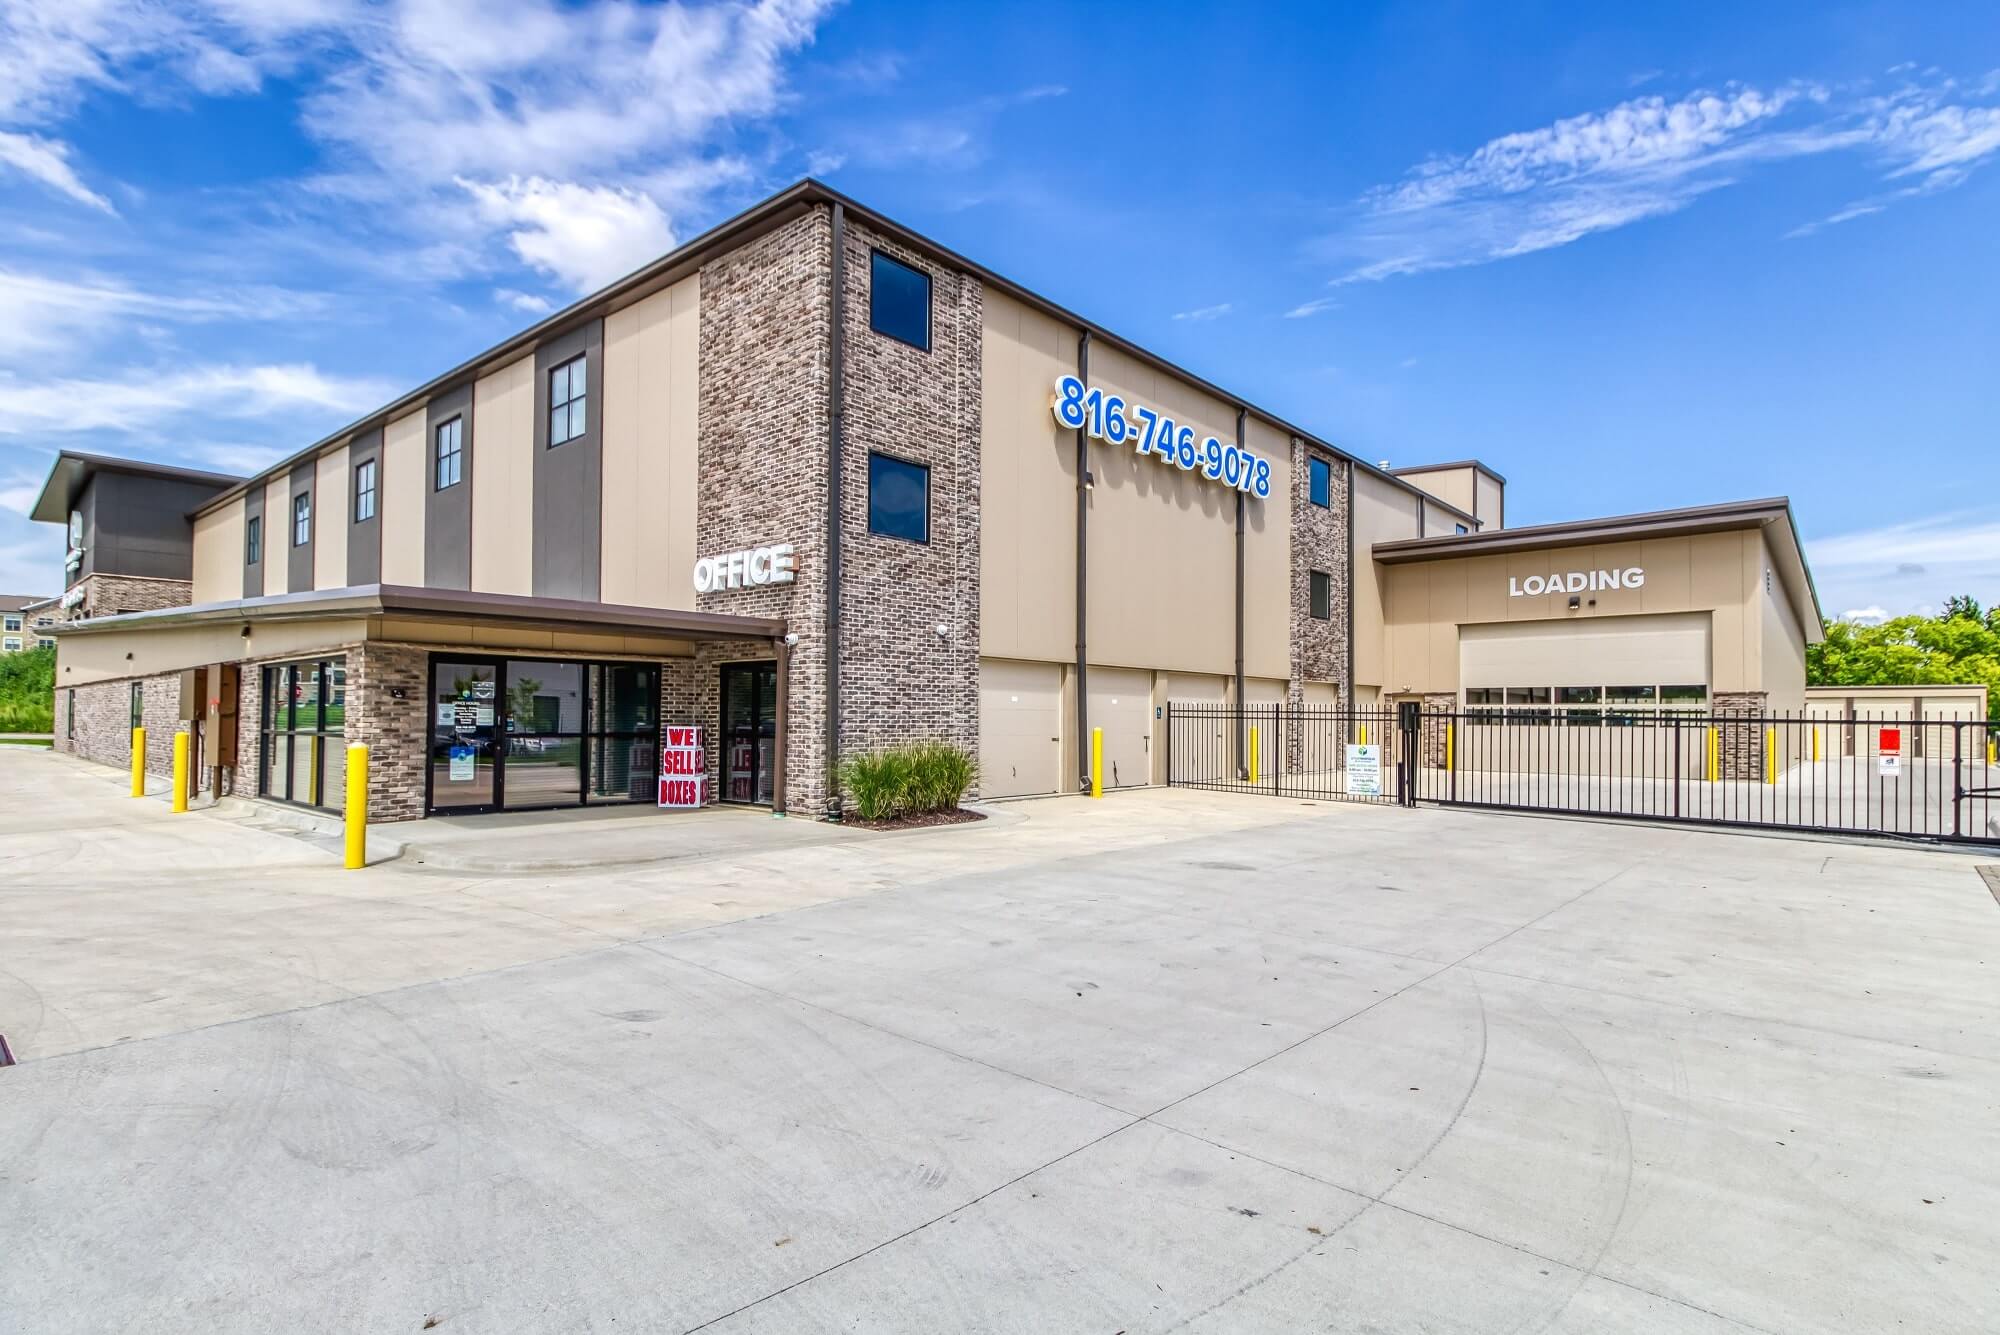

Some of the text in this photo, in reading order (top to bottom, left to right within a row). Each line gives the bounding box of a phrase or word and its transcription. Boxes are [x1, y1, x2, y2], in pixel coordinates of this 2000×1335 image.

[1054, 375, 1271, 499] 816-746-9078
[693, 543, 794, 592] OFFICE
[1509, 567, 1645, 597] LOADING
[669, 728, 694, 746] WE
[664, 751, 693, 775] SELL
[660, 780, 696, 805] BOXES
